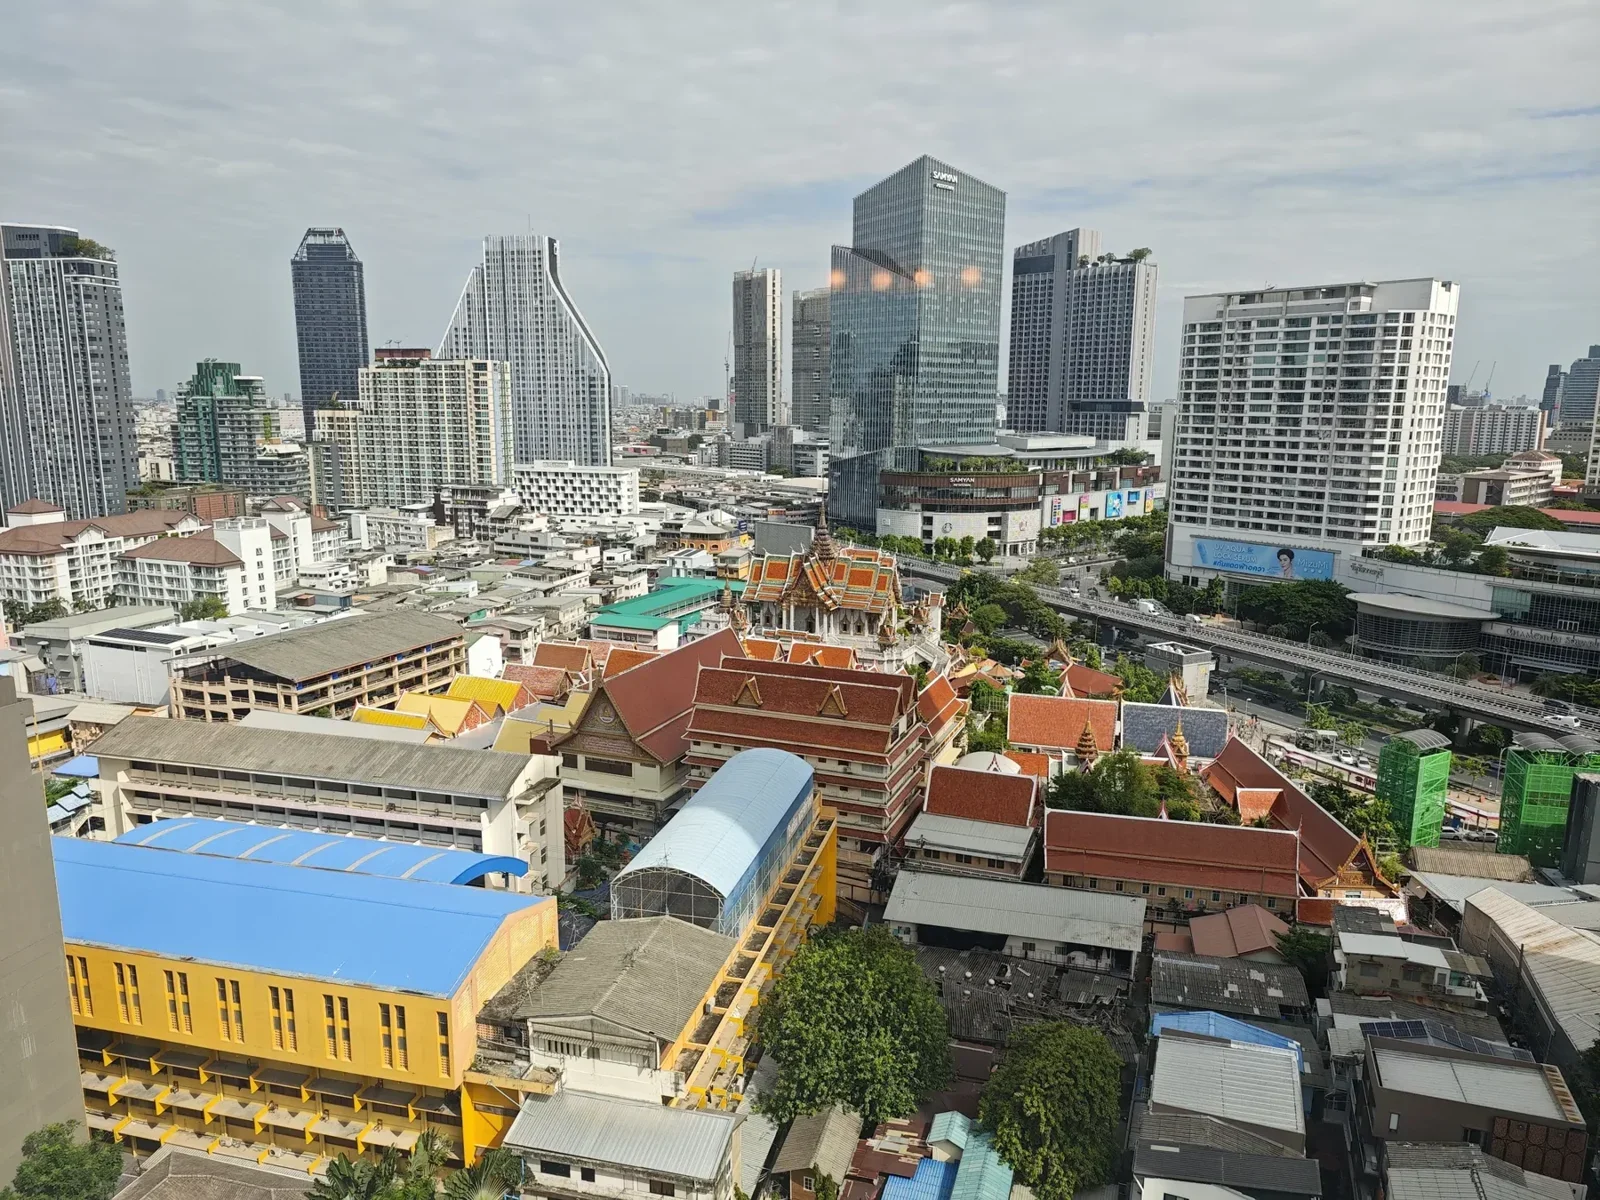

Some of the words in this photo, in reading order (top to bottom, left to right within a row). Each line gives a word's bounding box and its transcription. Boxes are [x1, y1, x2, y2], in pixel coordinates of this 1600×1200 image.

[1226, 545, 1246, 553] AQUA
[1213, 552, 1231, 560] LOCK
[1233, 555, 1257, 563] SERUM
[1297, 558, 1329, 570] MizuMi
